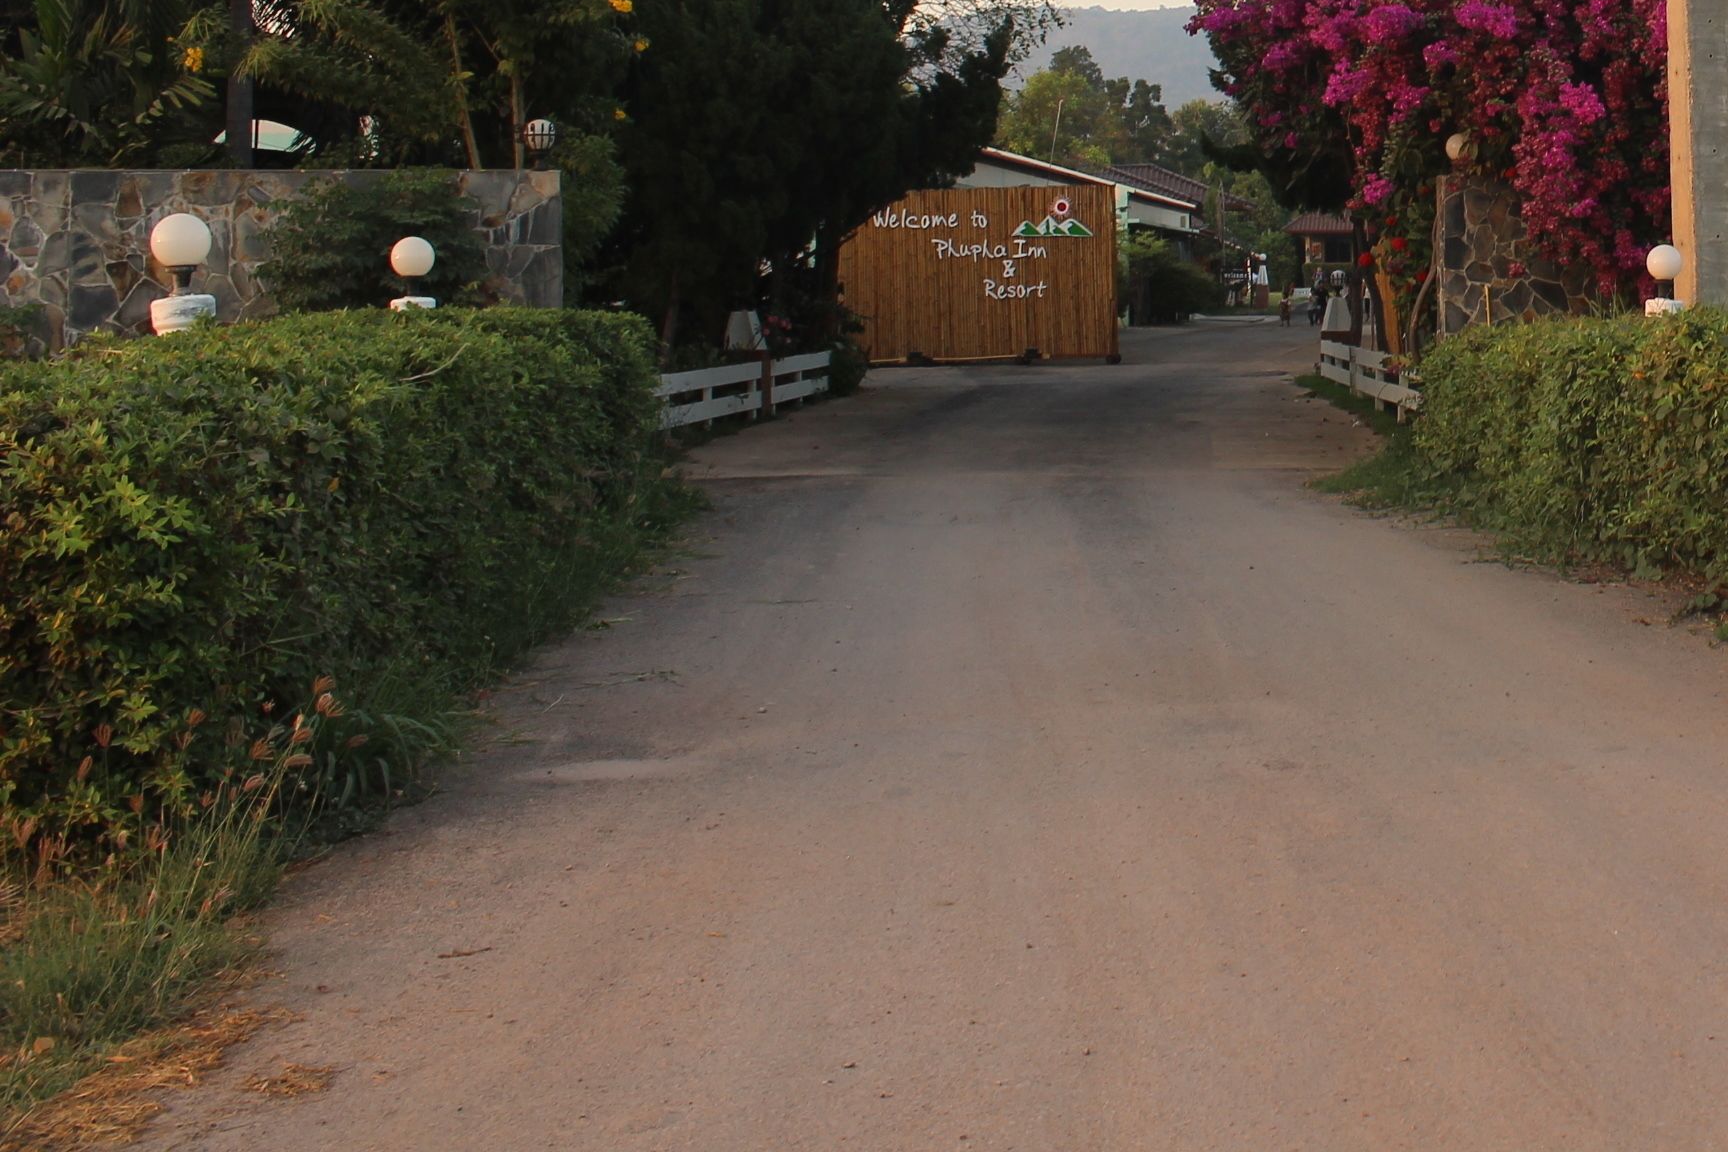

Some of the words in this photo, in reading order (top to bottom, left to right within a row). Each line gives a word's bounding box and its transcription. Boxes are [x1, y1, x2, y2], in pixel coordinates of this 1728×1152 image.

[873, 207, 959, 229] Welcome
[971, 210, 988, 228] to
[931, 238, 1007, 262] Phupha
[1013, 239, 1047, 259] Inn
[1002, 259, 1016, 278] &
[983, 278, 1047, 299] Resort
